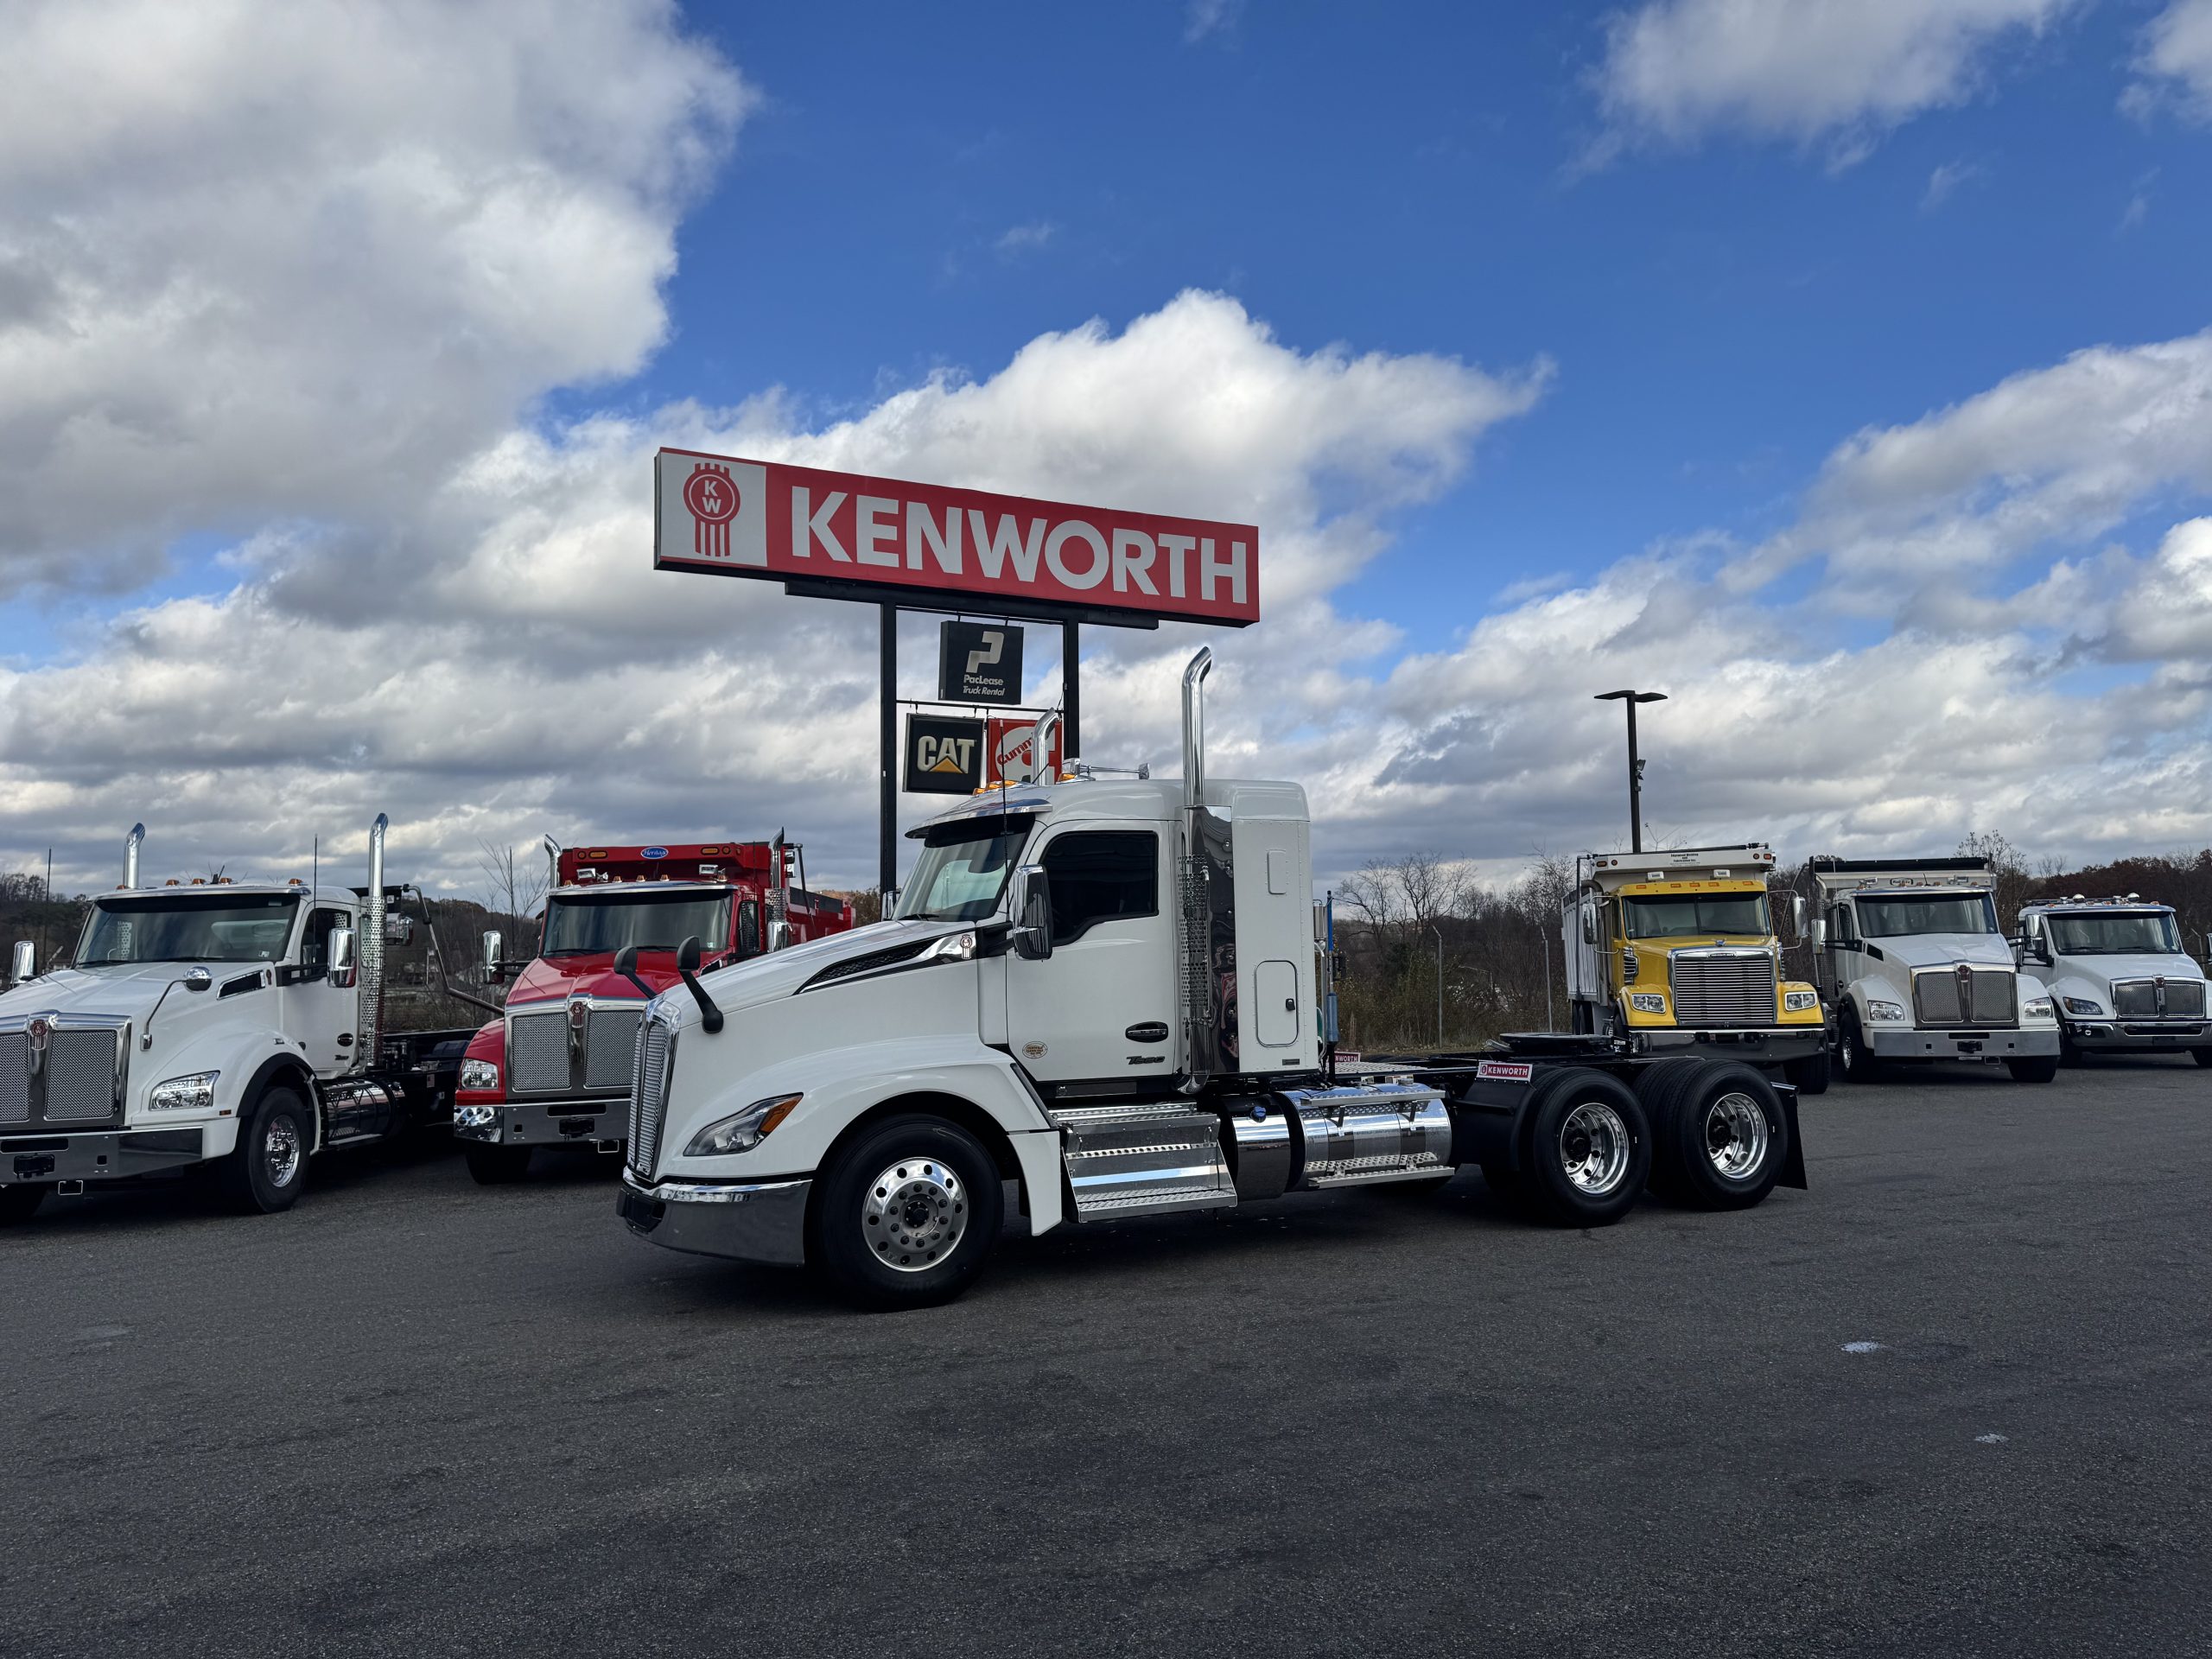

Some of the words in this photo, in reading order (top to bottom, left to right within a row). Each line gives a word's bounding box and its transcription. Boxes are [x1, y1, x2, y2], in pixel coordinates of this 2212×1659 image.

[791, 486, 1247, 604] KENWORTH
[963, 674, 1004, 685] PacLease
[963, 685, 982, 695] Truck
[982, 686, 1006, 696] Rental
[917, 735, 976, 774] CAT
[996, 738, 1032, 766] Cumm
[1488, 1066, 1529, 1076] KENWORTH
